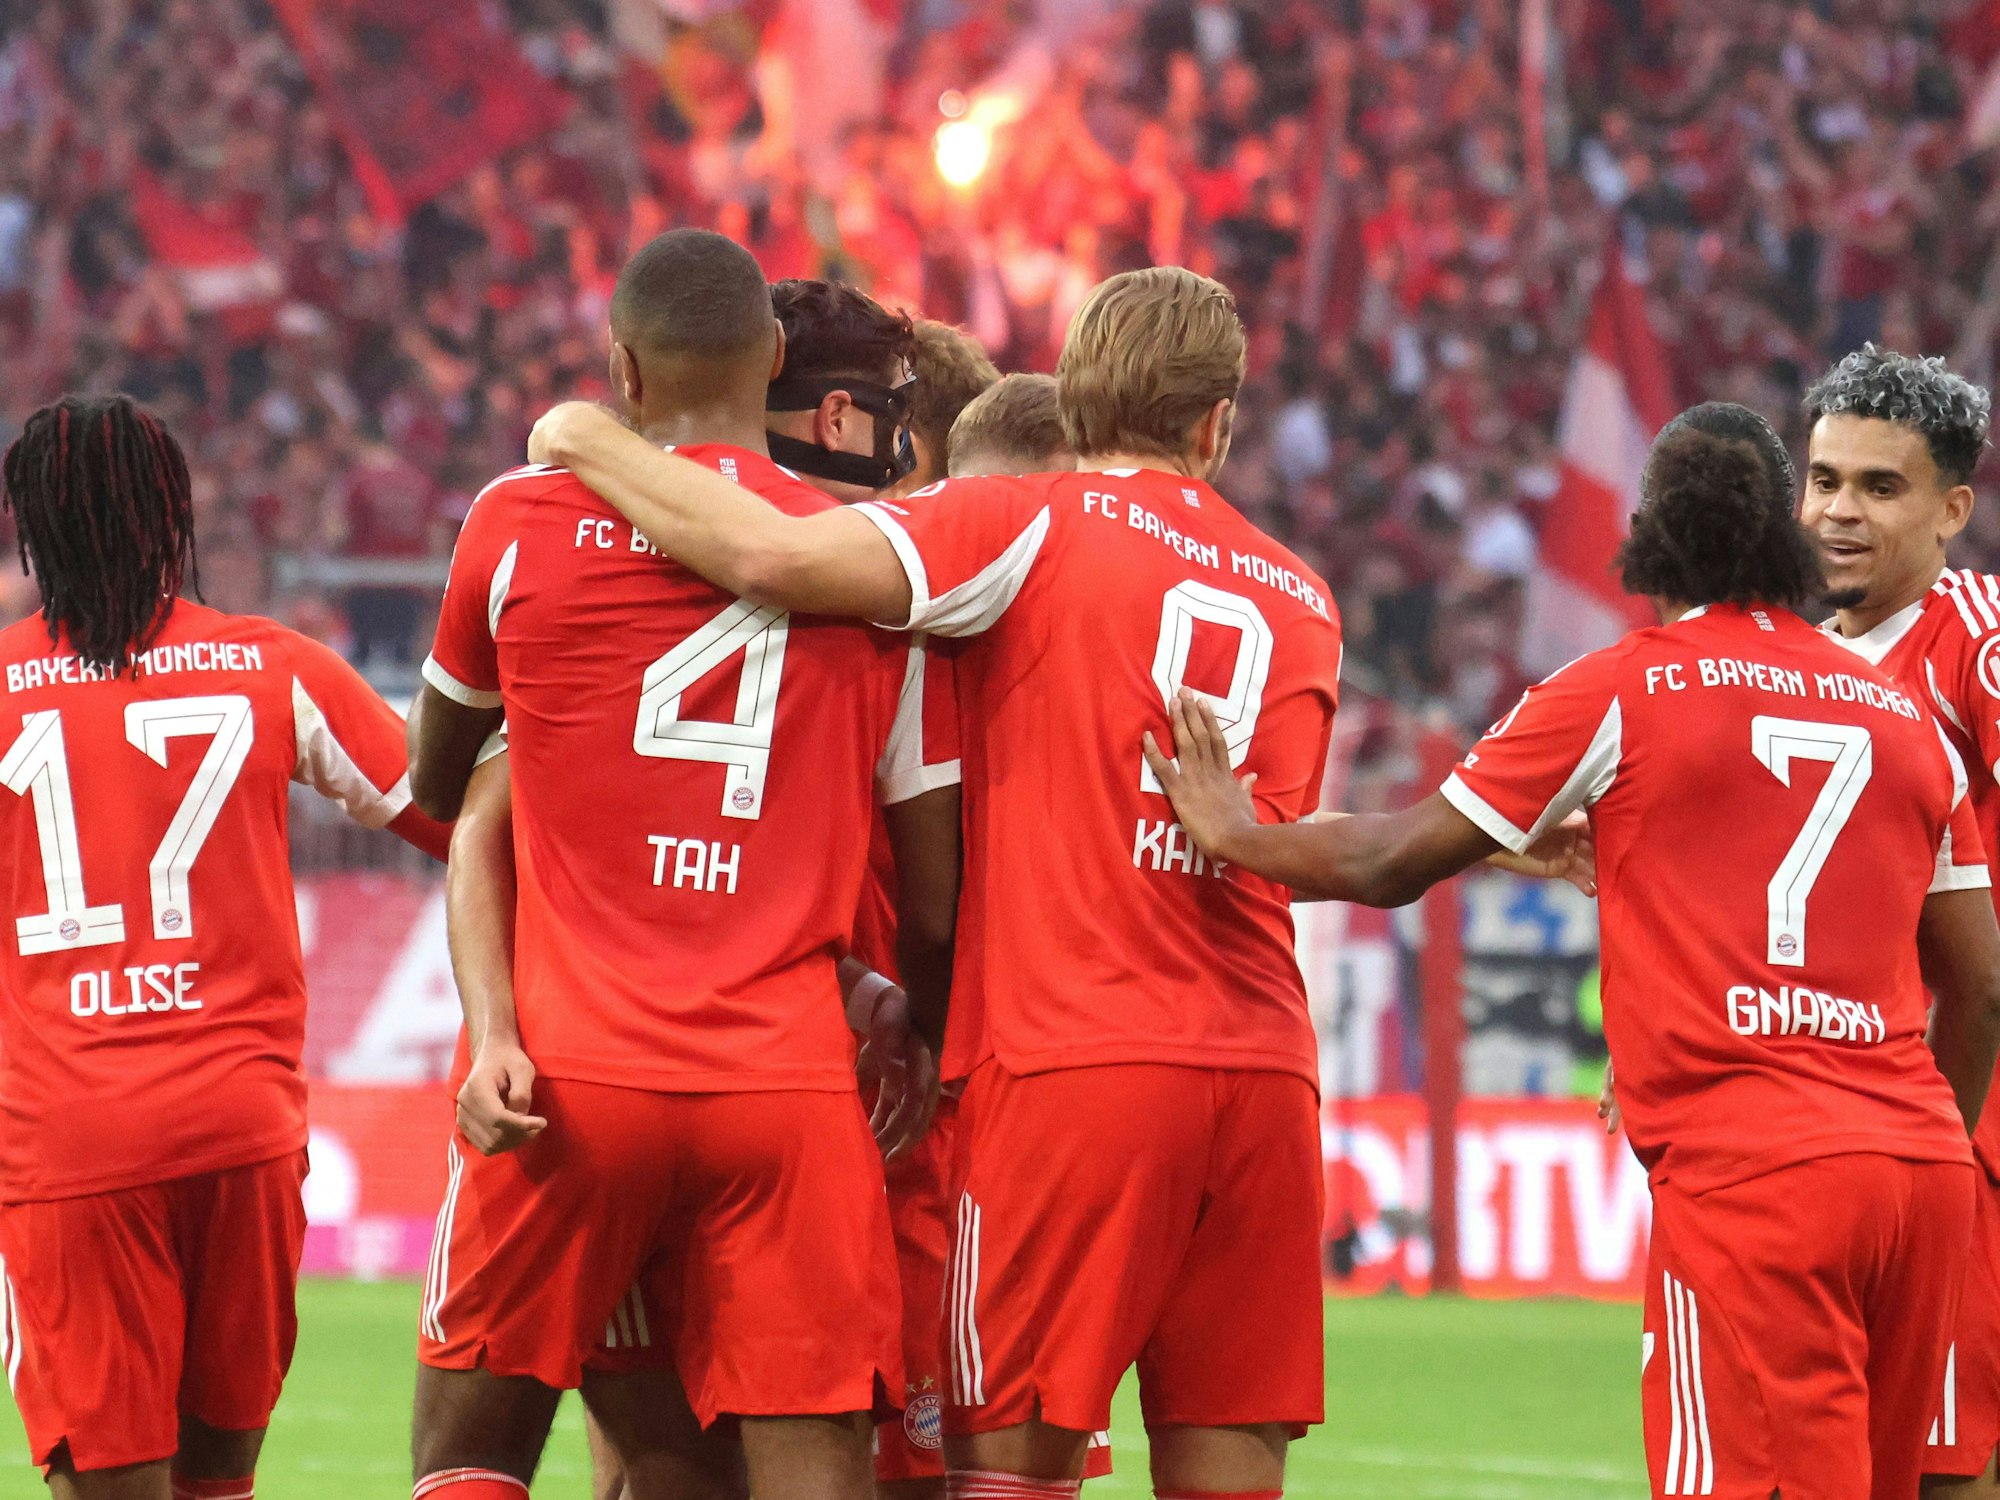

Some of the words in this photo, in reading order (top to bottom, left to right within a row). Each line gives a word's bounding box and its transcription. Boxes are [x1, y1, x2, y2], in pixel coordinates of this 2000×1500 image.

[719, 458, 736, 467] MIA
[575, 518, 615, 549] FC
[1083, 491, 1118, 519] FC
[1128, 502, 1219, 569] BAYERN
[1231, 550, 1331, 621] MÜNCHEN
[633, 599, 789, 820] 4
[1140, 579, 1274, 794] 9
[1645, 664, 1686, 694] FC
[1698, 658, 1806, 697] BAYERN
[1814, 672, 1921, 721] MÜNCHEN
[0, 695, 254, 956] 17
[1751, 715, 1872, 967] 7
[647, 835, 740, 894] TAH
[70, 962, 203, 1017] OLISE
[1726, 985, 1886, 1044] GNABRY
